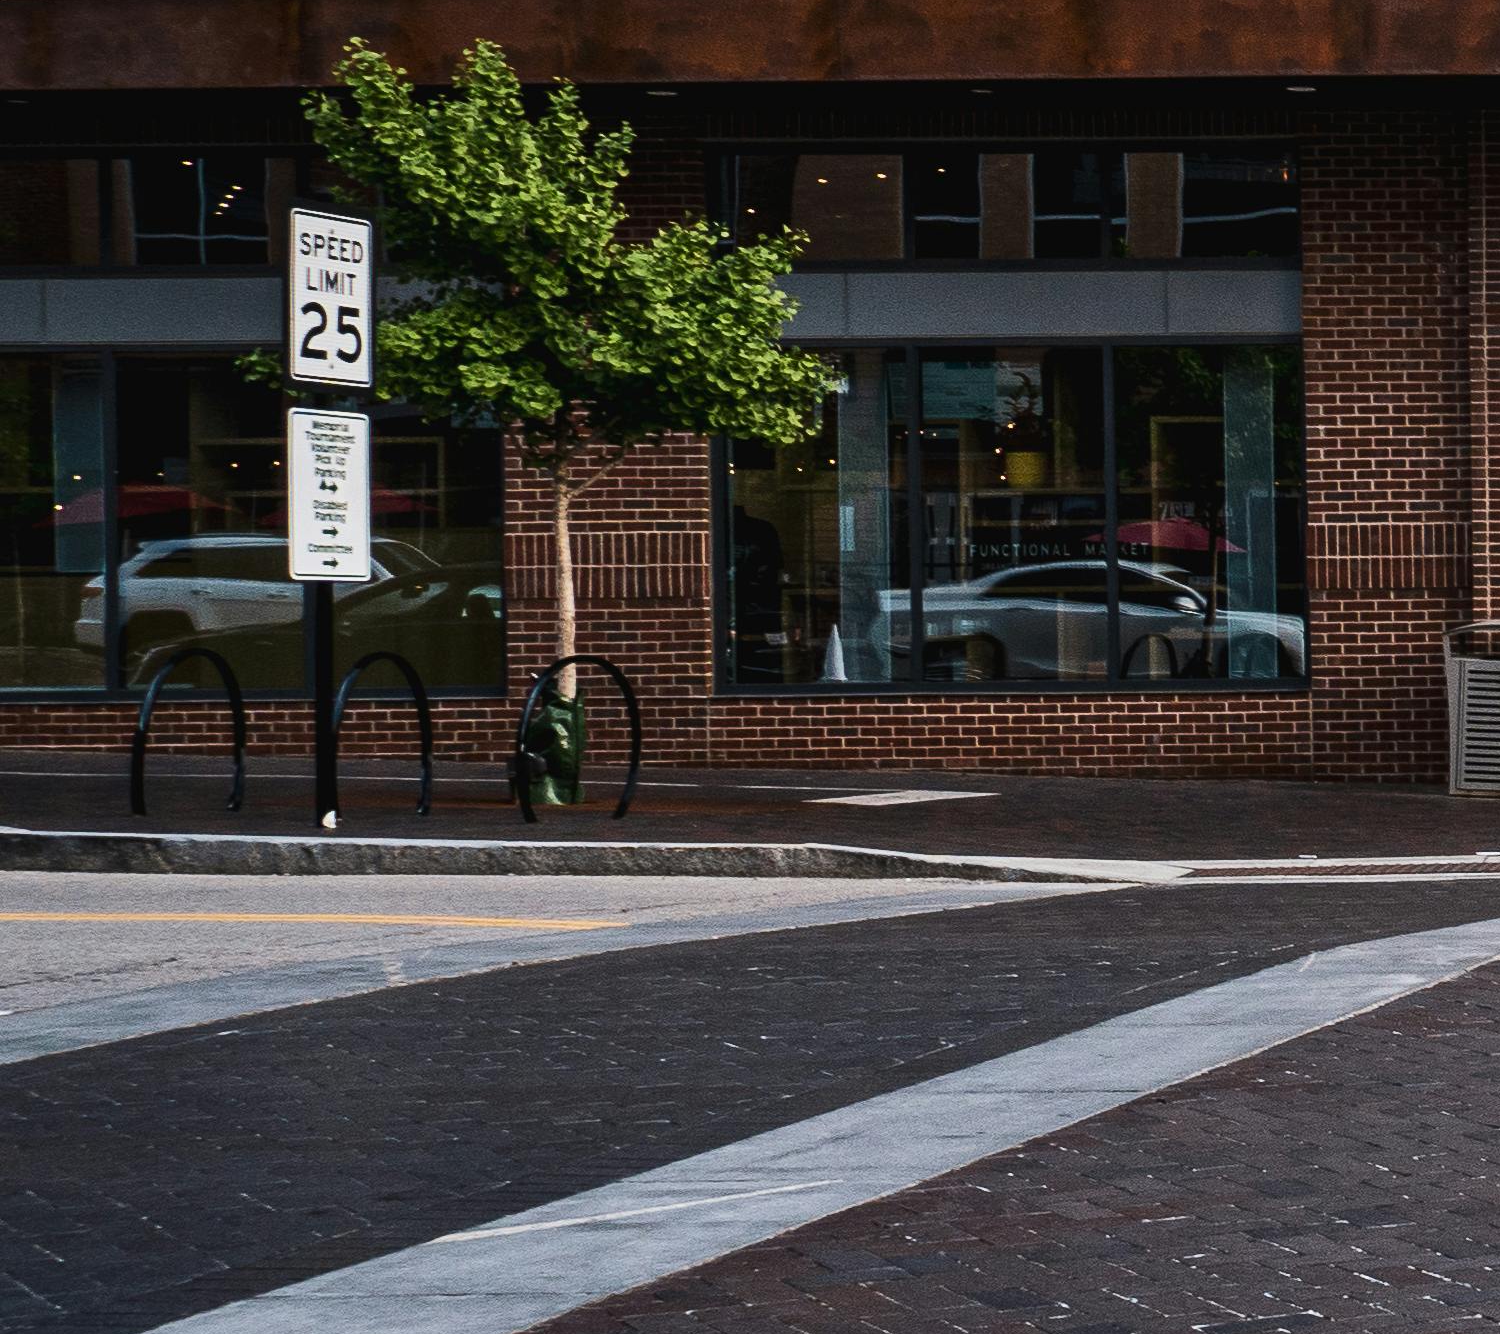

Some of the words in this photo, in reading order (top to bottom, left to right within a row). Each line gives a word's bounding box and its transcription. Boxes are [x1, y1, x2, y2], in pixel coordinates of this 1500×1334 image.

[300, 232, 363, 264] SPEED
[306, 266, 357, 296] LIMIT
[300, 301, 362, 364] 25
[969, 541, 1071, 558] FUNCTIONAL
[1084, 541, 1150, 557] MAKET
